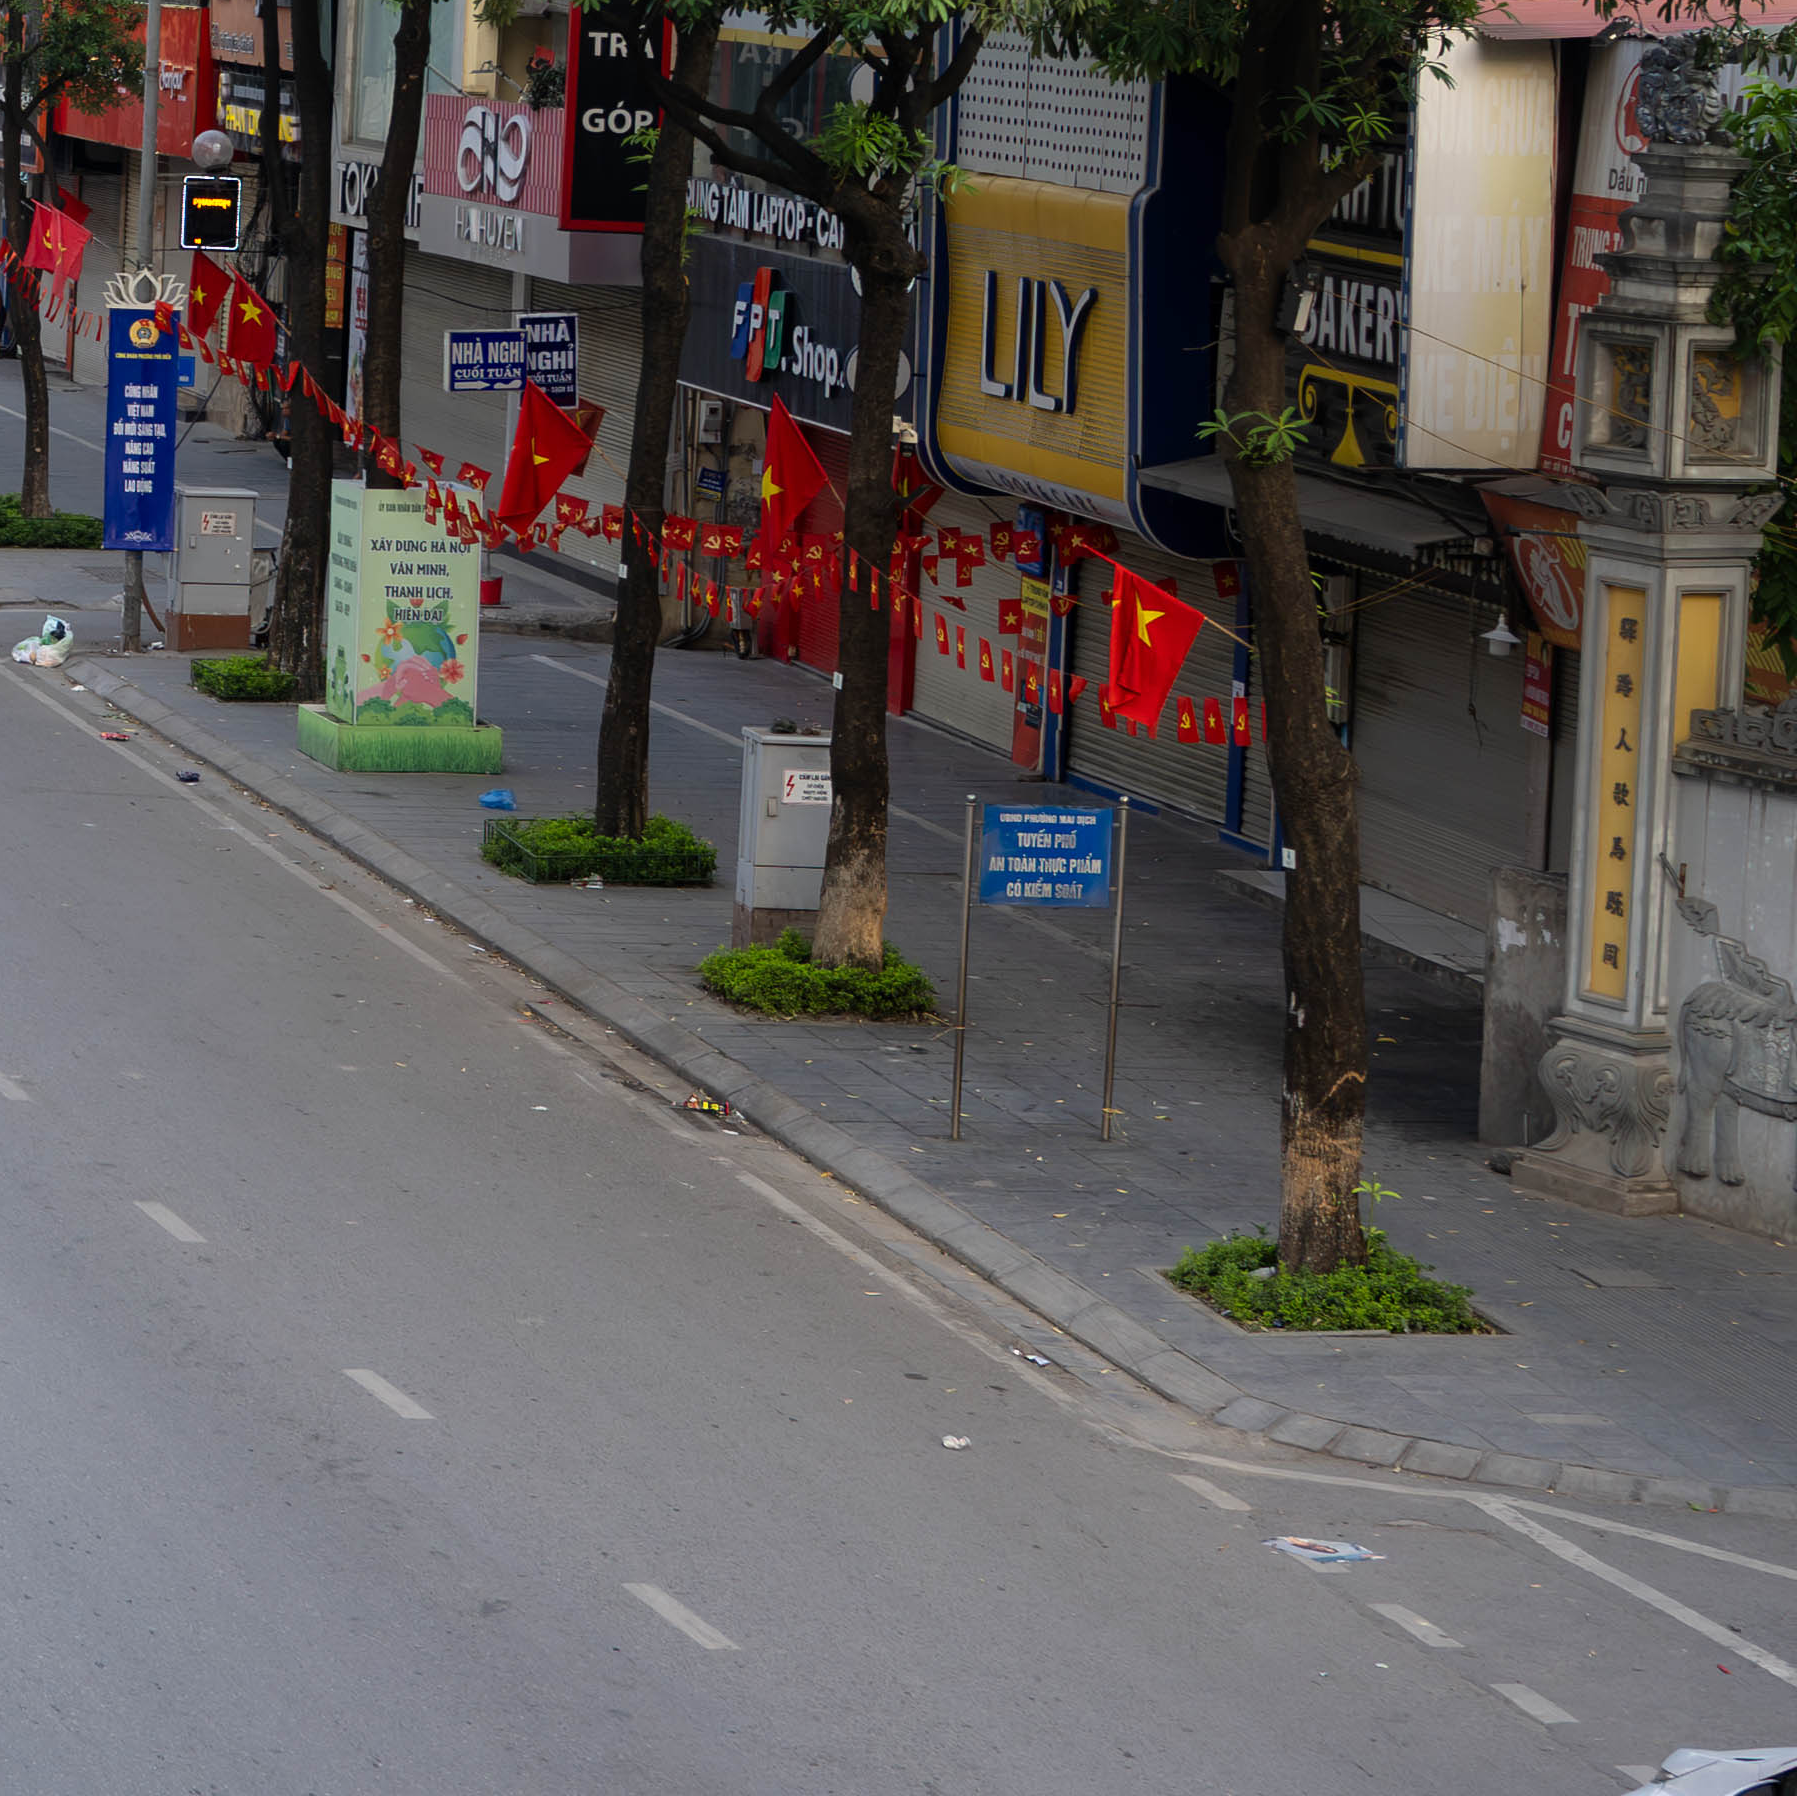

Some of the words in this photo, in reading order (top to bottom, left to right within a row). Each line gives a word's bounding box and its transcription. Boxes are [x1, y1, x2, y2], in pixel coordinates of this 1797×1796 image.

[582, 100, 654, 135] GÓP
[1608, 163, 1635, 192] Dầu
[722, 175, 750, 230] TÂM
[753, 192, 806, 242] LAPTOP
[1420, 214, 1462, 294] XE
[1471, 197, 1548, 294] MÁY
[525, 319, 571, 343] NHÀ
[980, 270, 1099, 414] LILY
[451, 337, 484, 365] NHÀ
[488, 334, 525, 365] NGHỈ
[527, 342, 574, 371] NGHỈ
[454, 365, 484, 379] CUỐI
[1416, 352, 1456, 435] XE
[1462, 336, 1542, 452] ĐIỆN
[124, 479, 136, 493] LAO
[370, 537, 393, 552] XÂY
[395, 539, 427, 555] DỰNG
[384, 585, 423, 599] THANH
[1059, 815, 1076, 825] MAI
[1017, 828, 1052, 849] TUYẾN
[1054, 829, 1078, 850] PHỐ
[988, 855, 1006, 872] AN
[1007, 854, 1037, 873] TOÀN
[1068, 852, 1102, 875] PHẨM
[1006, 879, 1022, 898] CÓ
[1023, 877, 1053, 899] KIỂM
[1054, 881, 1084, 900] SOÁT
